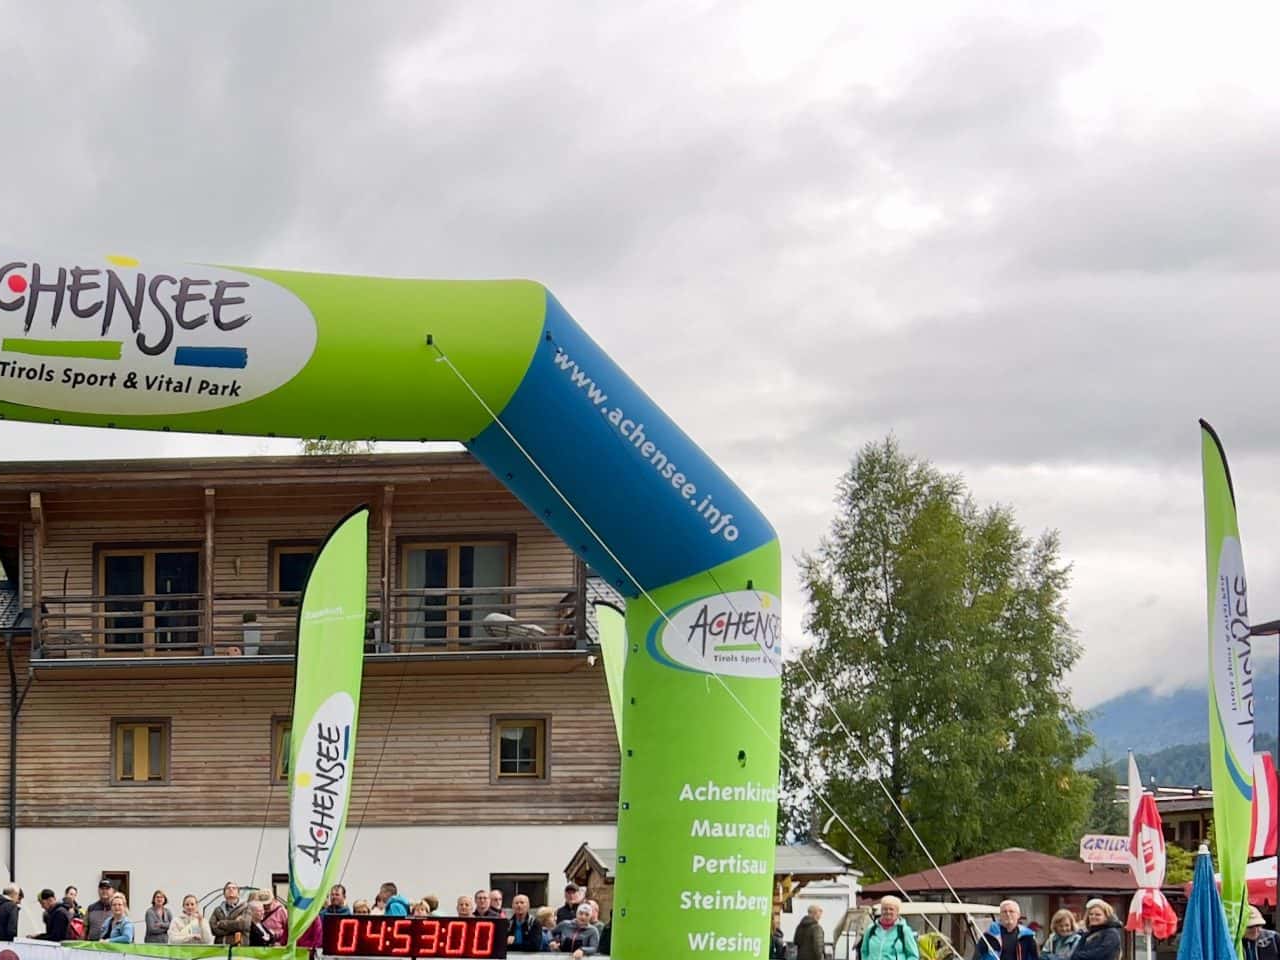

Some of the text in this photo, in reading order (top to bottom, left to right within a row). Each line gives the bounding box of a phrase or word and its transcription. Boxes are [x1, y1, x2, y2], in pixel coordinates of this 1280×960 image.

[0, 361, 242, 398] Tirols Sport & Vital Park
[552, 346, 740, 543] www.achensee.info
[297, 721, 347, 866] ACHENSEE
[691, 818, 770, 839] Maurach
[692, 853, 768, 875] Pertisau
[680, 890, 769, 917] Steinberg
[336, 918, 495, 955] 04:53:00
[687, 931, 762, 958] Wiesing
